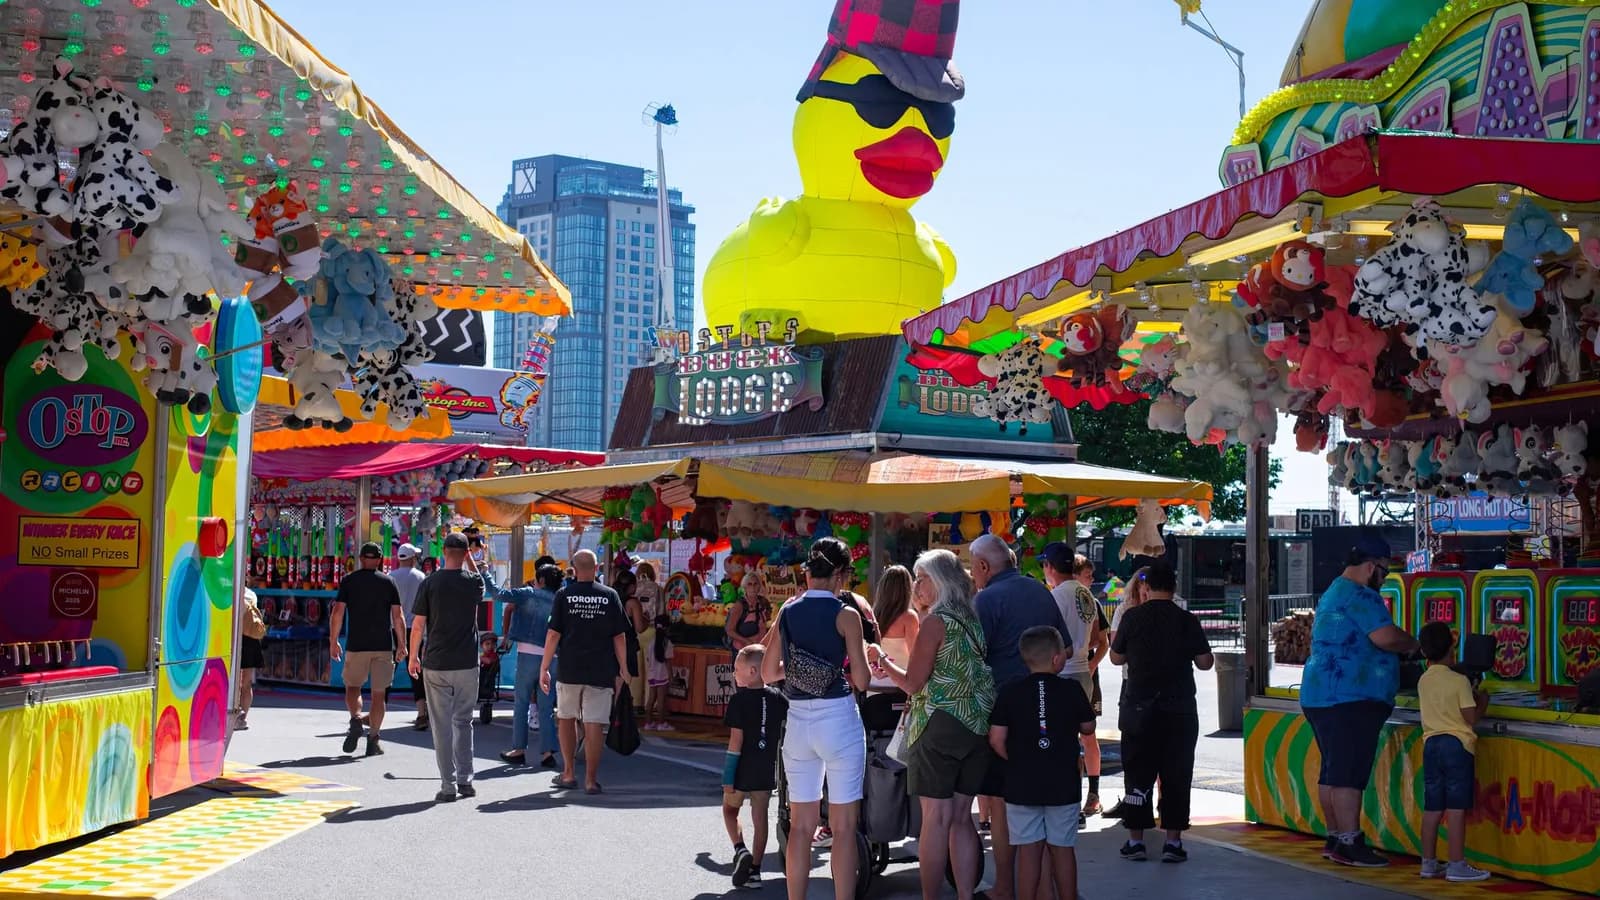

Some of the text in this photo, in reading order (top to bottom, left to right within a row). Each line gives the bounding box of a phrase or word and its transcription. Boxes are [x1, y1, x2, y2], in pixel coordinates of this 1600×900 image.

[515, 161, 537, 169] HOTEL
[675, 344, 800, 376] DUCK
[422, 396, 459, 408] stop
[676, 371, 793, 425] LODGE
[24, 474, 140, 489] RACING
[1458, 499, 1482, 518] LONG
[1483, 498, 1503, 518] HOT
[1301, 514, 1331, 530] BAR
[69, 524, 106, 540] EVERY
[107, 525, 136, 541] RACE
[31, 546, 129, 560] NO Small Prizes
[566, 595, 609, 605] TORONTO
[707, 695, 731, 705] HUNT
[1038, 680, 1046, 718] Motorsport
